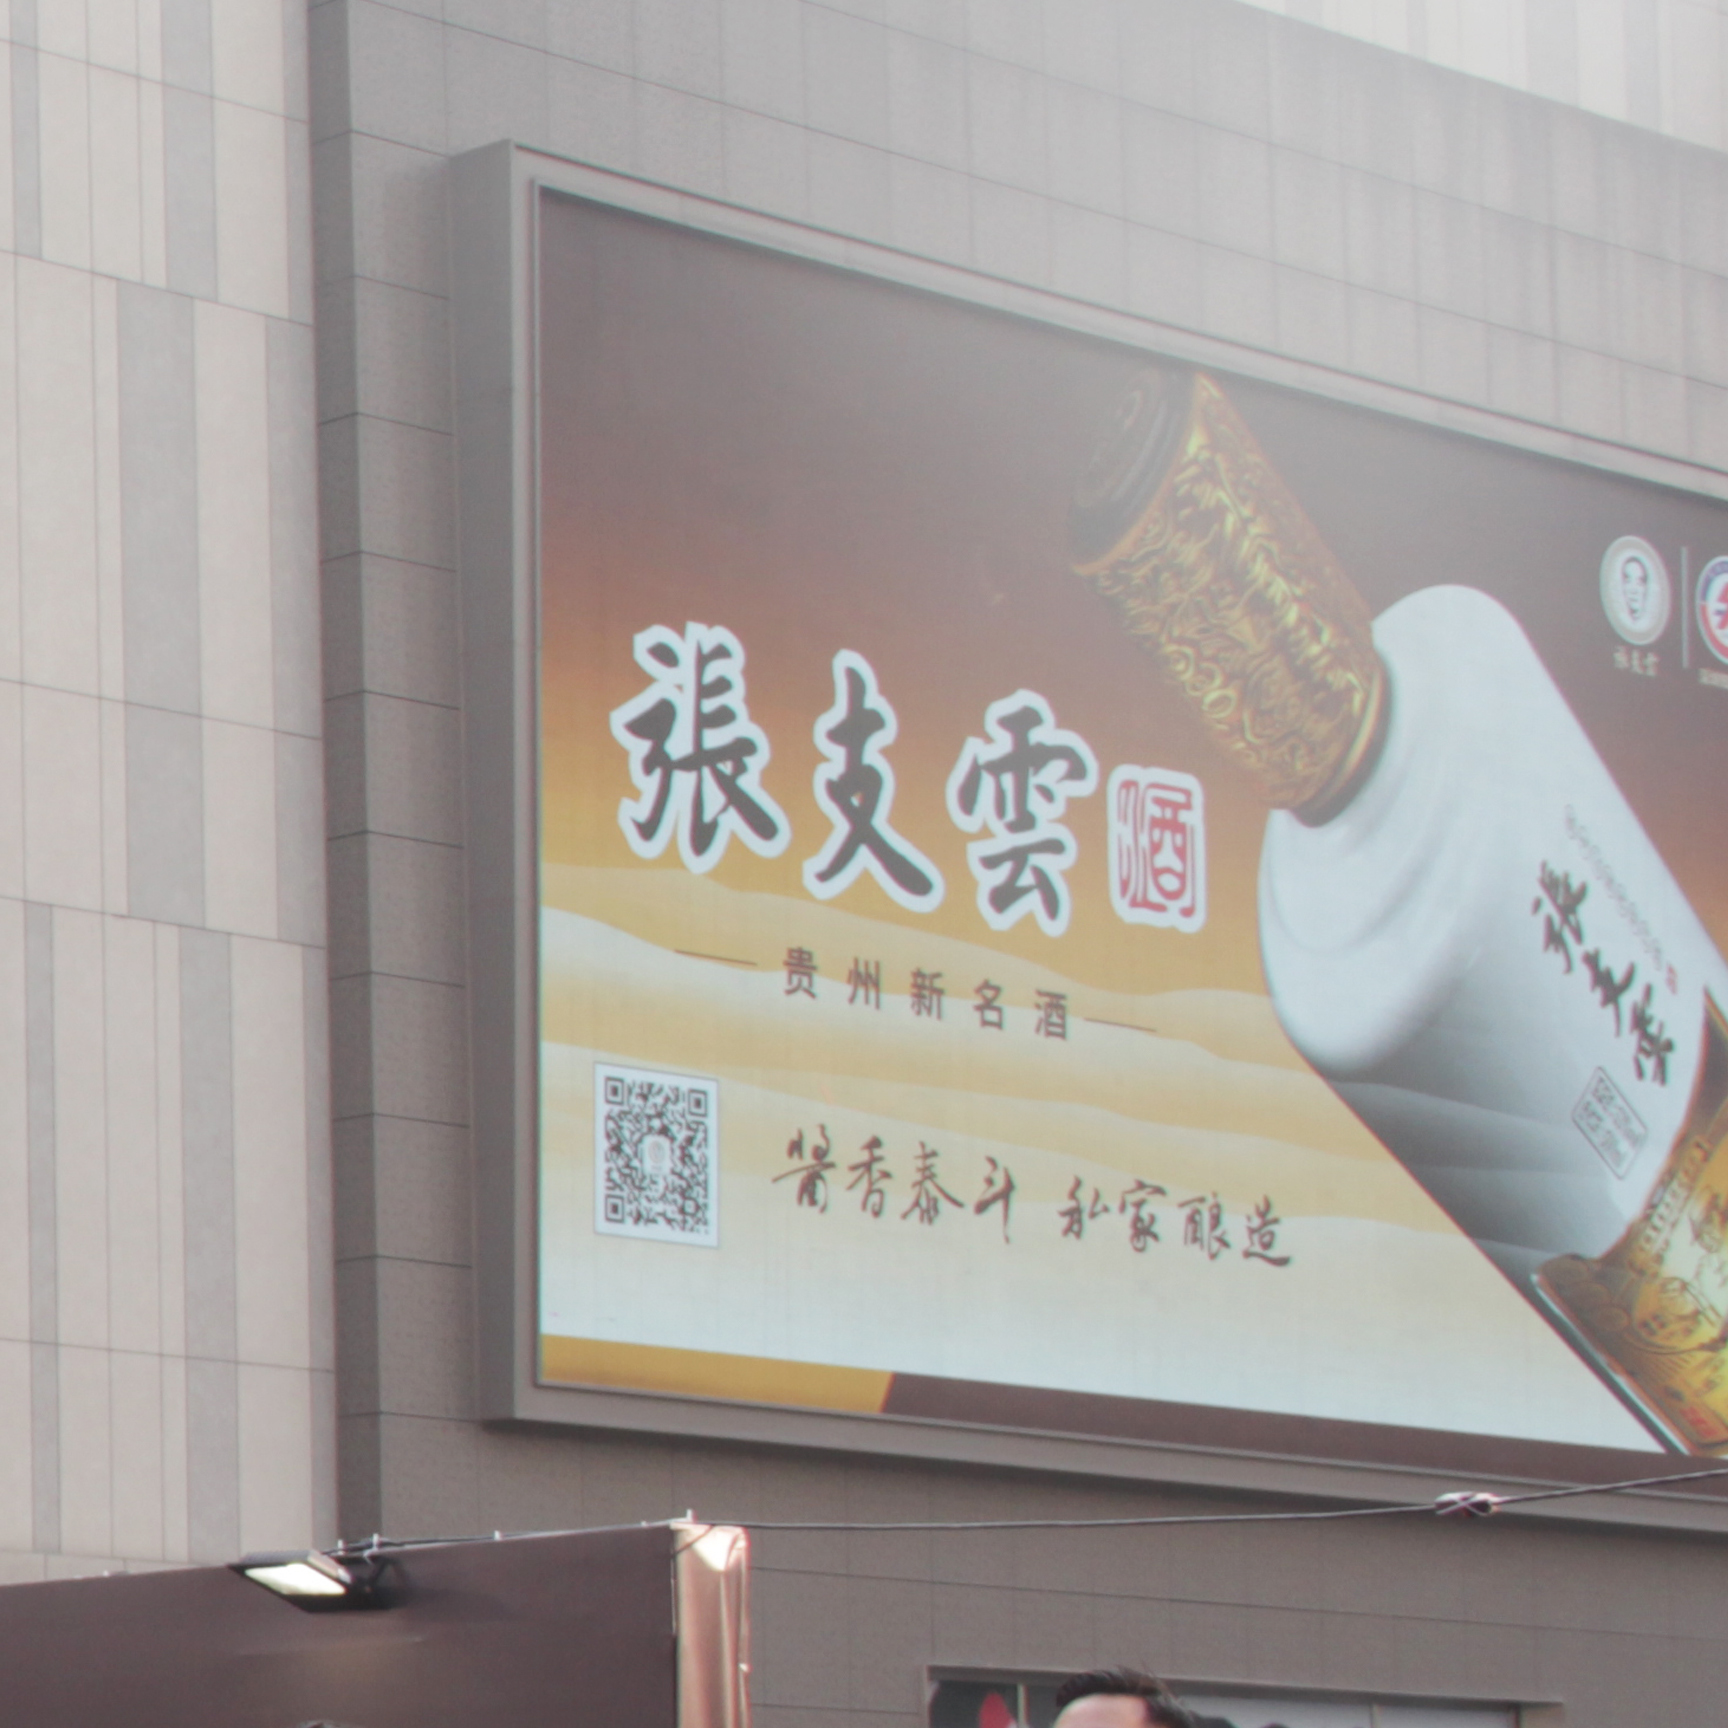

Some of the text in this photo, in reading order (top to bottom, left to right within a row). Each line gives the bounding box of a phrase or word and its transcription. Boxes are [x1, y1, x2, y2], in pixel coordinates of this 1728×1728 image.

[781, 945, 1072, 1042] 贵州新名酒
